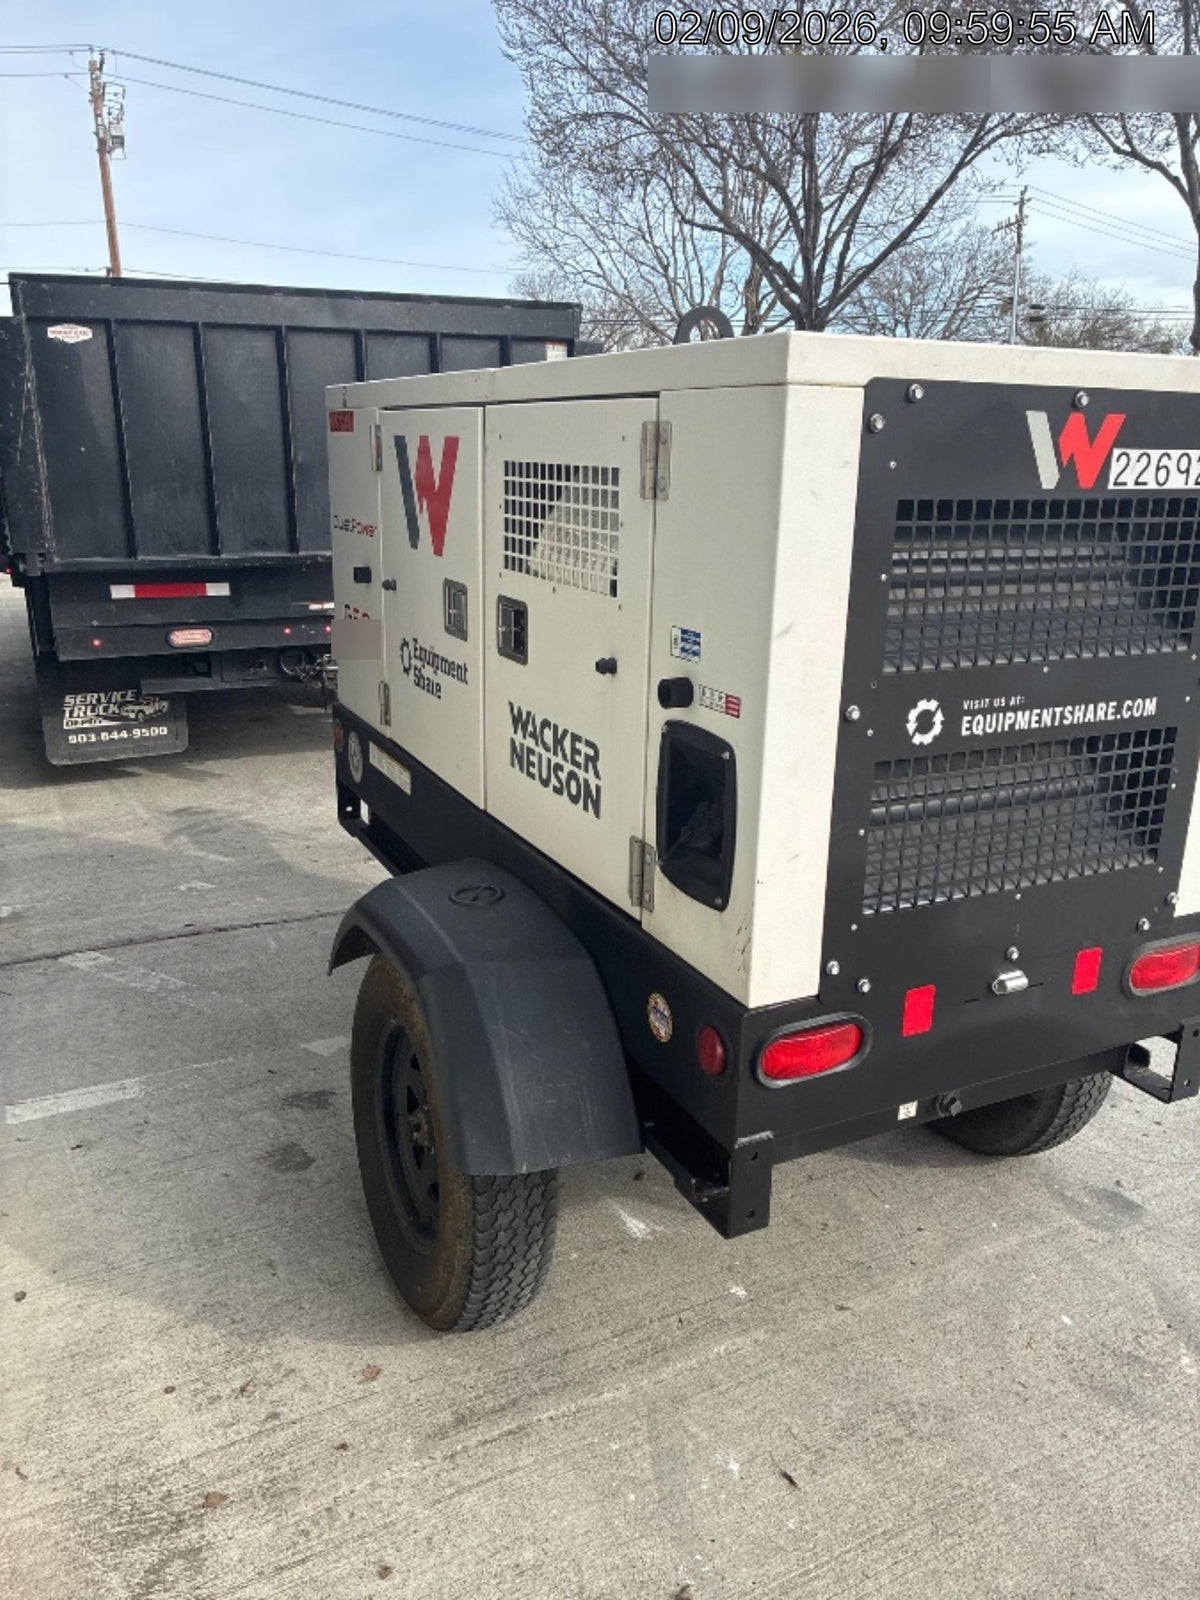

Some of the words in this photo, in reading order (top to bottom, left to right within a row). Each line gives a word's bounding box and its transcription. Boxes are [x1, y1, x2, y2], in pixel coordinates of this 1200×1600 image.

[412, 637, 468, 685] Equipment
[63, 689, 137, 707] SERVICE
[413, 665, 441, 700] Share
[62, 703, 120, 718] TRUCK
[961, 697, 1158, 737] EQUIPMENTSHARE.COM
[963, 698, 990, 710] VISIT
[993, 697, 1005, 708] US
[508, 700, 602, 781] WACKER
[510, 737, 602, 821] NEUSON
